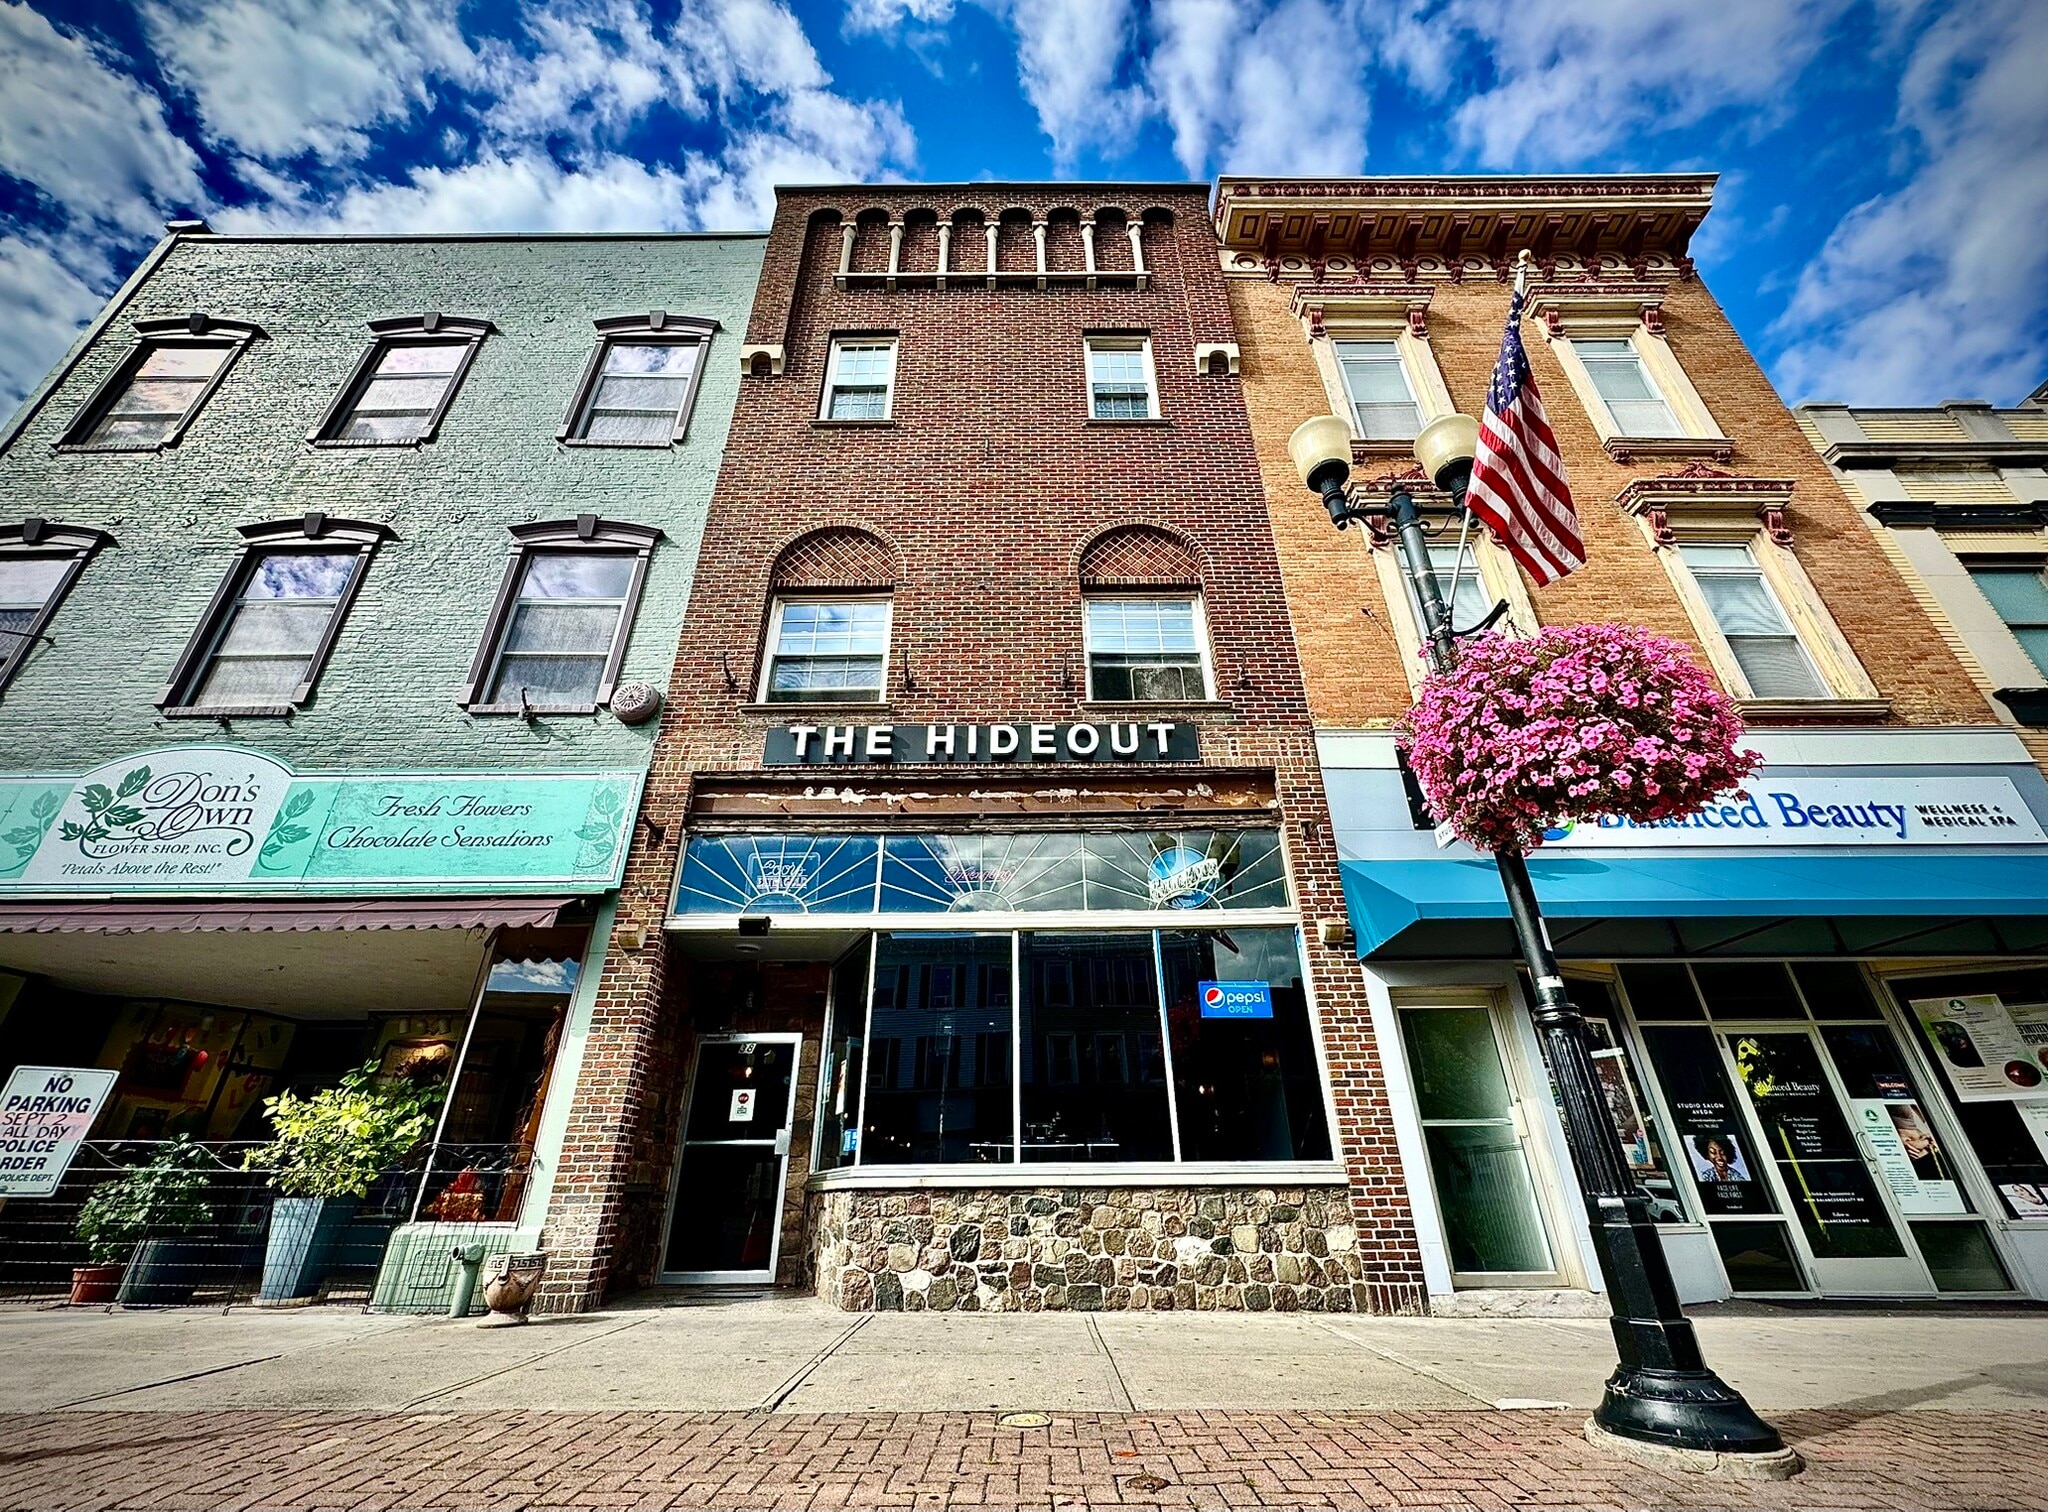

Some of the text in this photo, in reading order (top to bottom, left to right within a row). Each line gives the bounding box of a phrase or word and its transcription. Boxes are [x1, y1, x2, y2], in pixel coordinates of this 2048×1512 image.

[788, 722, 1176, 756] THE HIDEOUT
[142, 772, 261, 810] Don's
[371, 795, 533, 817] Fresh Flowers
[1914, 803, 1987, 815] WELLNESS
[157, 801, 254, 841] Own
[1767, 793, 1907, 839] Beauty
[1921, 815, 2018, 827] MEDICAL SPA
[327, 824, 554, 849] Chocolate Sensations
[92, 844, 222, 855] FLOWER SHOP, INC.
[106, 863, 154, 875] Above
[155, 862, 182, 875] the
[182, 862, 223, 874] Rest!"
[762, 859, 806, 876] Coors
[1226, 990, 1266, 1005] pepsi
[1228, 1005, 1253, 1013] OPEN
[43, 1077, 74, 1093] NO
[1790, 1081, 1820, 1094] Beauty
[4, 1095, 92, 1113] PARKING
[2, 1112, 68, 1126] SEPT. 2
[3, 1125, 71, 1140] ALL DAY
[0, 1157, 48, 1170] RDER
[0, 1173, 54, 1182] POLICE DEPT.
